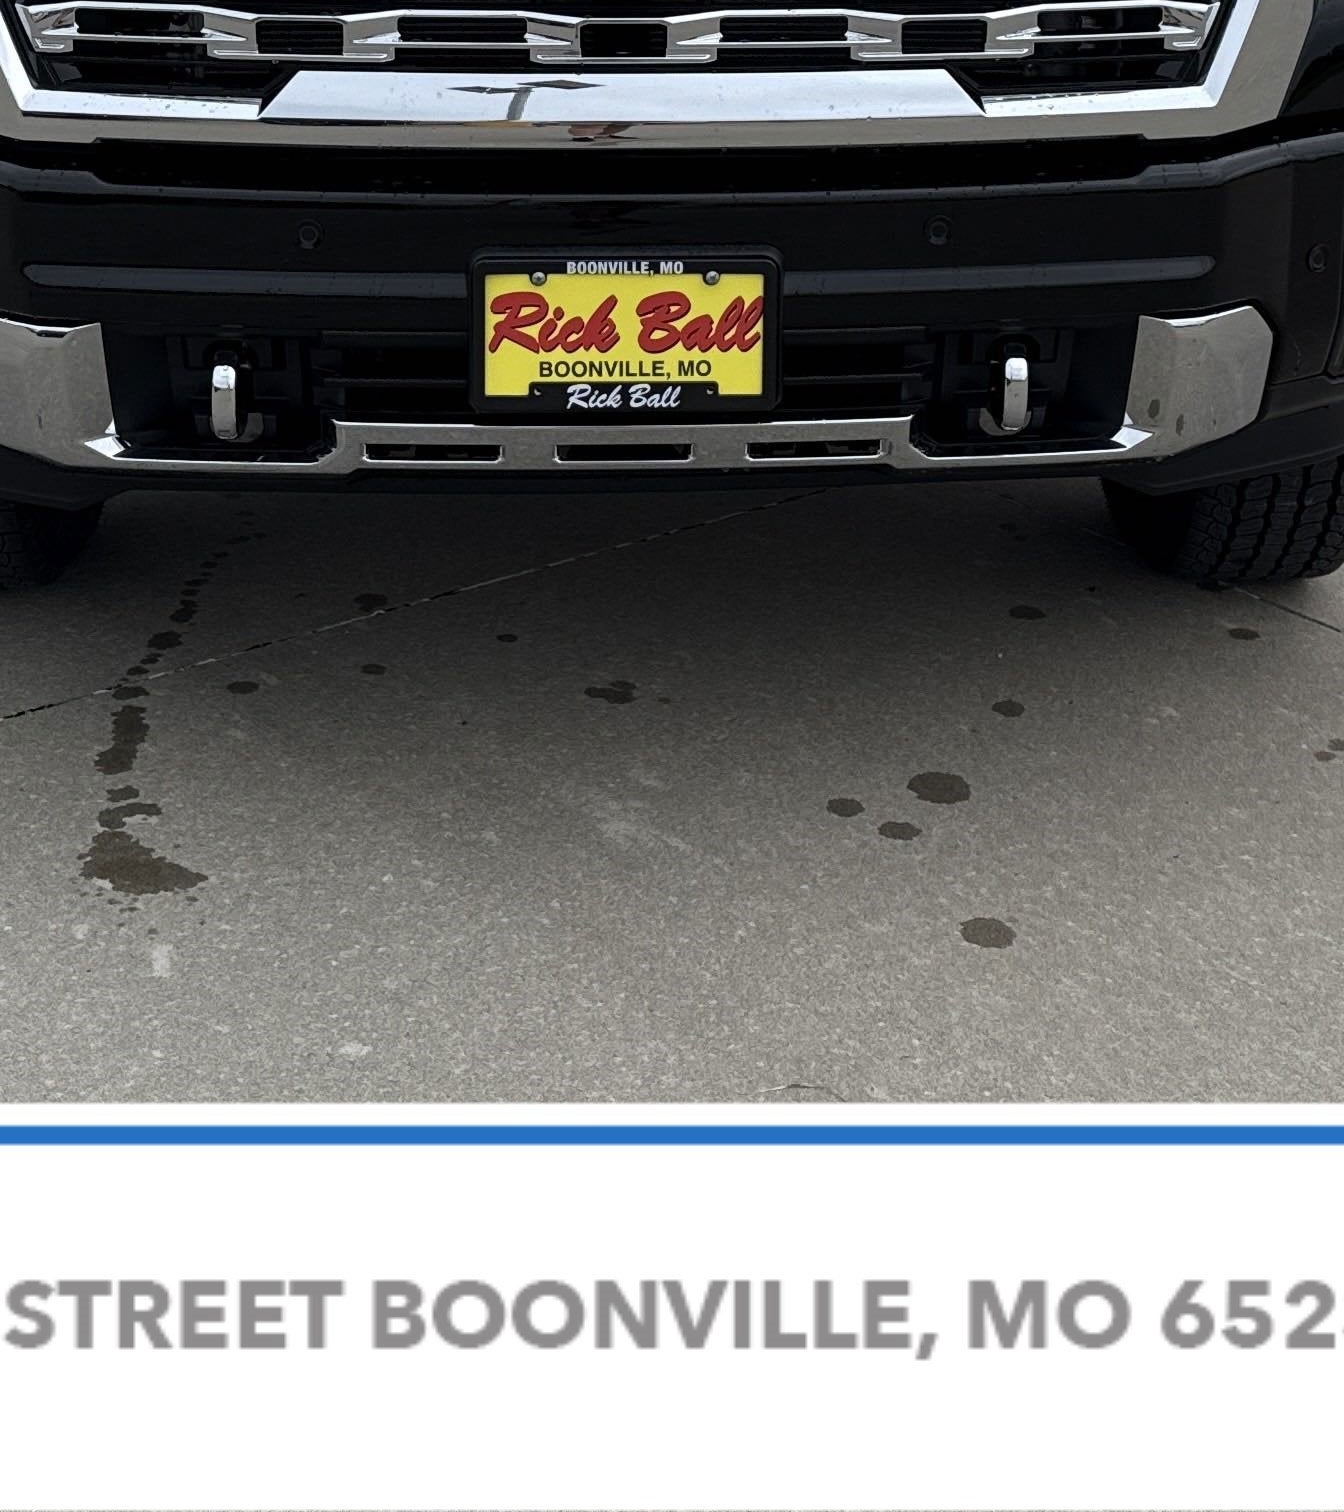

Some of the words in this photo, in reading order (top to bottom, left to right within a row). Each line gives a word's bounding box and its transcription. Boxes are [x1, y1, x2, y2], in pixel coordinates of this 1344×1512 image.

[566, 261, 654, 276] BOONVILLE,
[660, 261, 684, 274] MO
[489, 291, 621, 354] Rick
[635, 291, 764, 353] Ball
[538, 361, 671, 380] BOONVILLE,
[677, 360, 712, 376] MO
[566, 384, 625, 409] Rick
[628, 385, 681, 408] Ball
